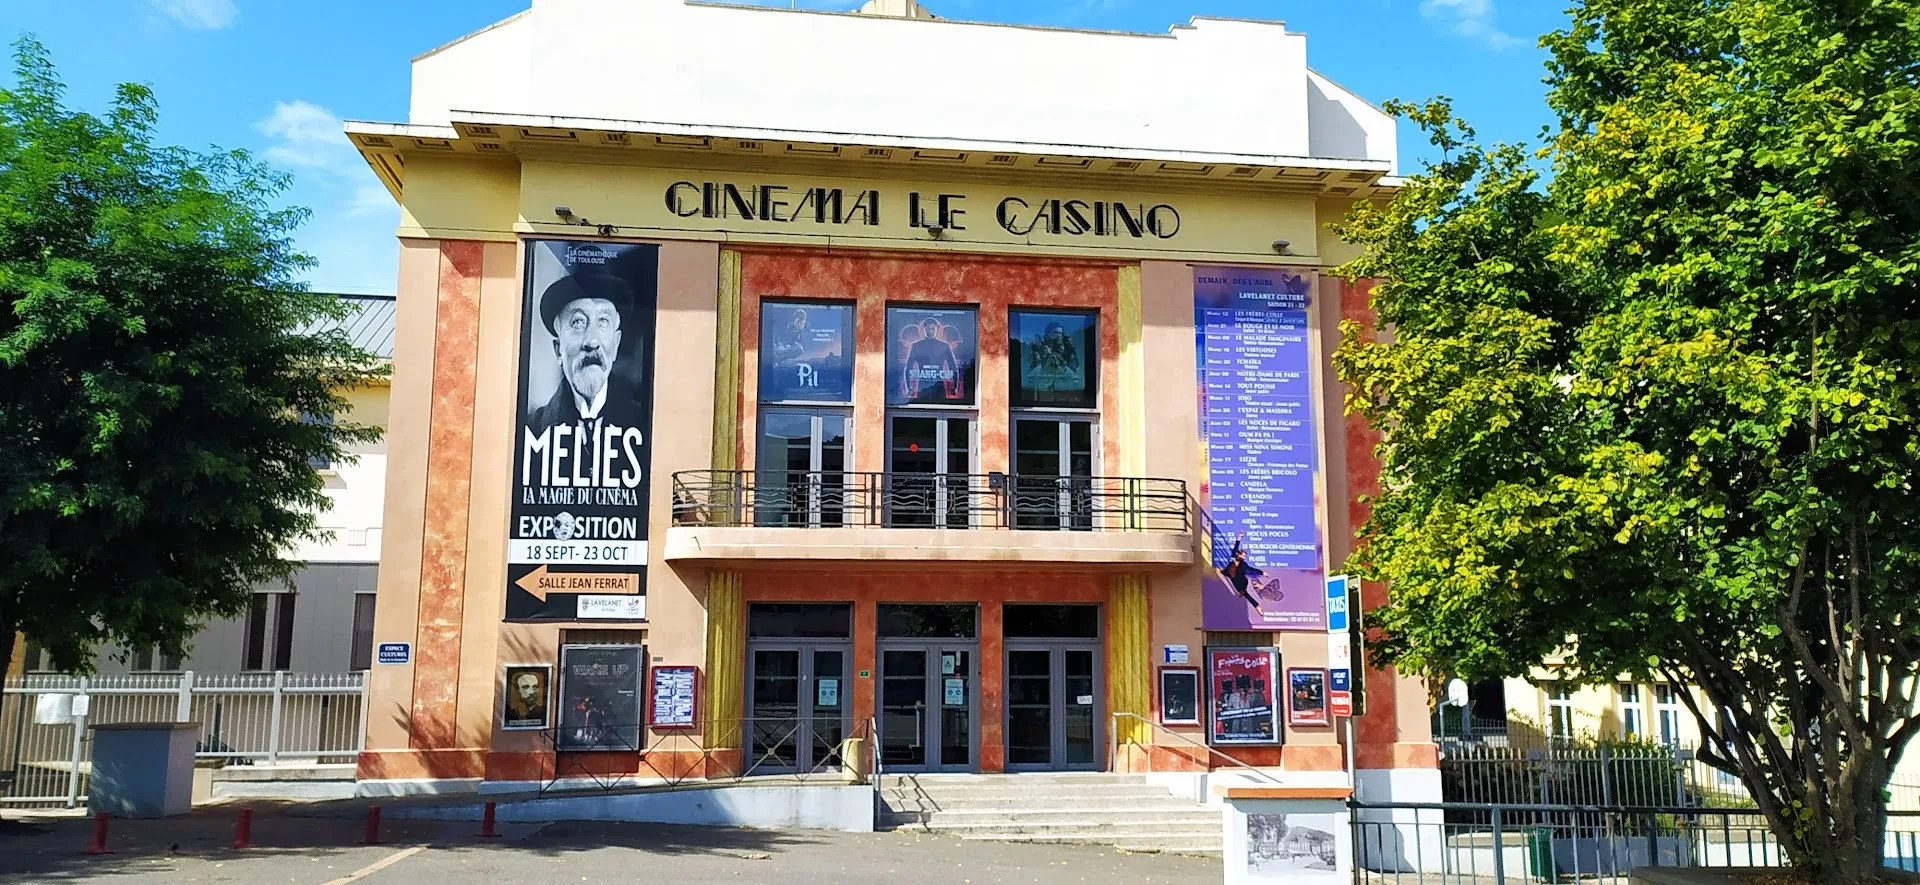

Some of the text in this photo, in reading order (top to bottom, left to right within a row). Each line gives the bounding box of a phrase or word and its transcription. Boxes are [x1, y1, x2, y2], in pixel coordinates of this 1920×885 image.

[665, 181, 1180, 239] CINEMA LE CASINO
[1239, 292, 1275, 300] LAVELANET
[797, 363, 819, 387] Pil
[523, 486, 638, 506] LA MAGIE DU CINÉMA
[526, 546, 541, 560] 18
[584, 546, 598, 560] 23
[602, 546, 628, 561] OCT
[538, 576, 630, 589] SALLE JEAN FERRAT
[1328, 596, 1345, 614] TAXIS
[573, 663, 629, 676] WAKE UP
